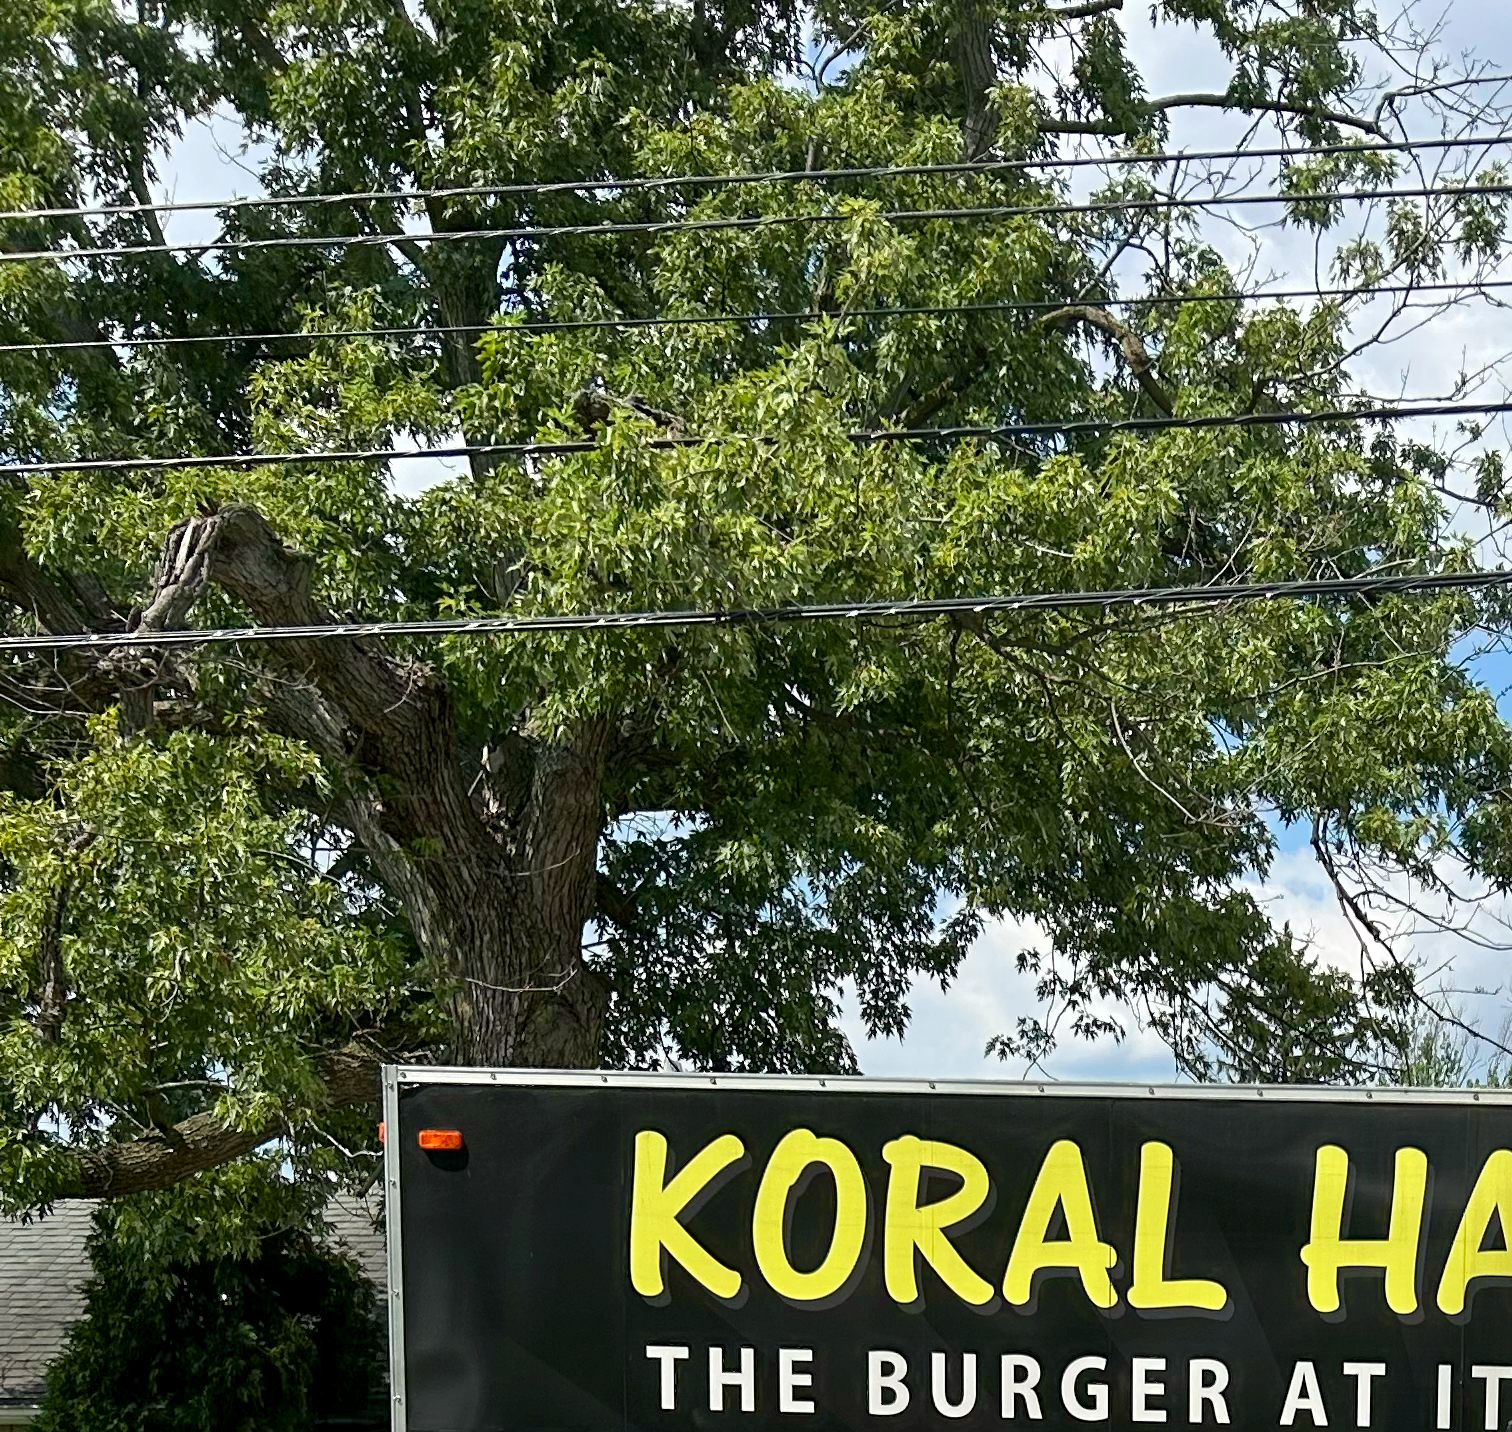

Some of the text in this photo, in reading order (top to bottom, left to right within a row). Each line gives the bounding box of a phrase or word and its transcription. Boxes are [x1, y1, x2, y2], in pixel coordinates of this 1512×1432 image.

[631, 1129, 1227, 1310] KORAL
[646, 1346, 814, 1413] THE
[869, 1351, 1230, 1423] BURGER
[1280, 1362, 1385, 1427] AT
